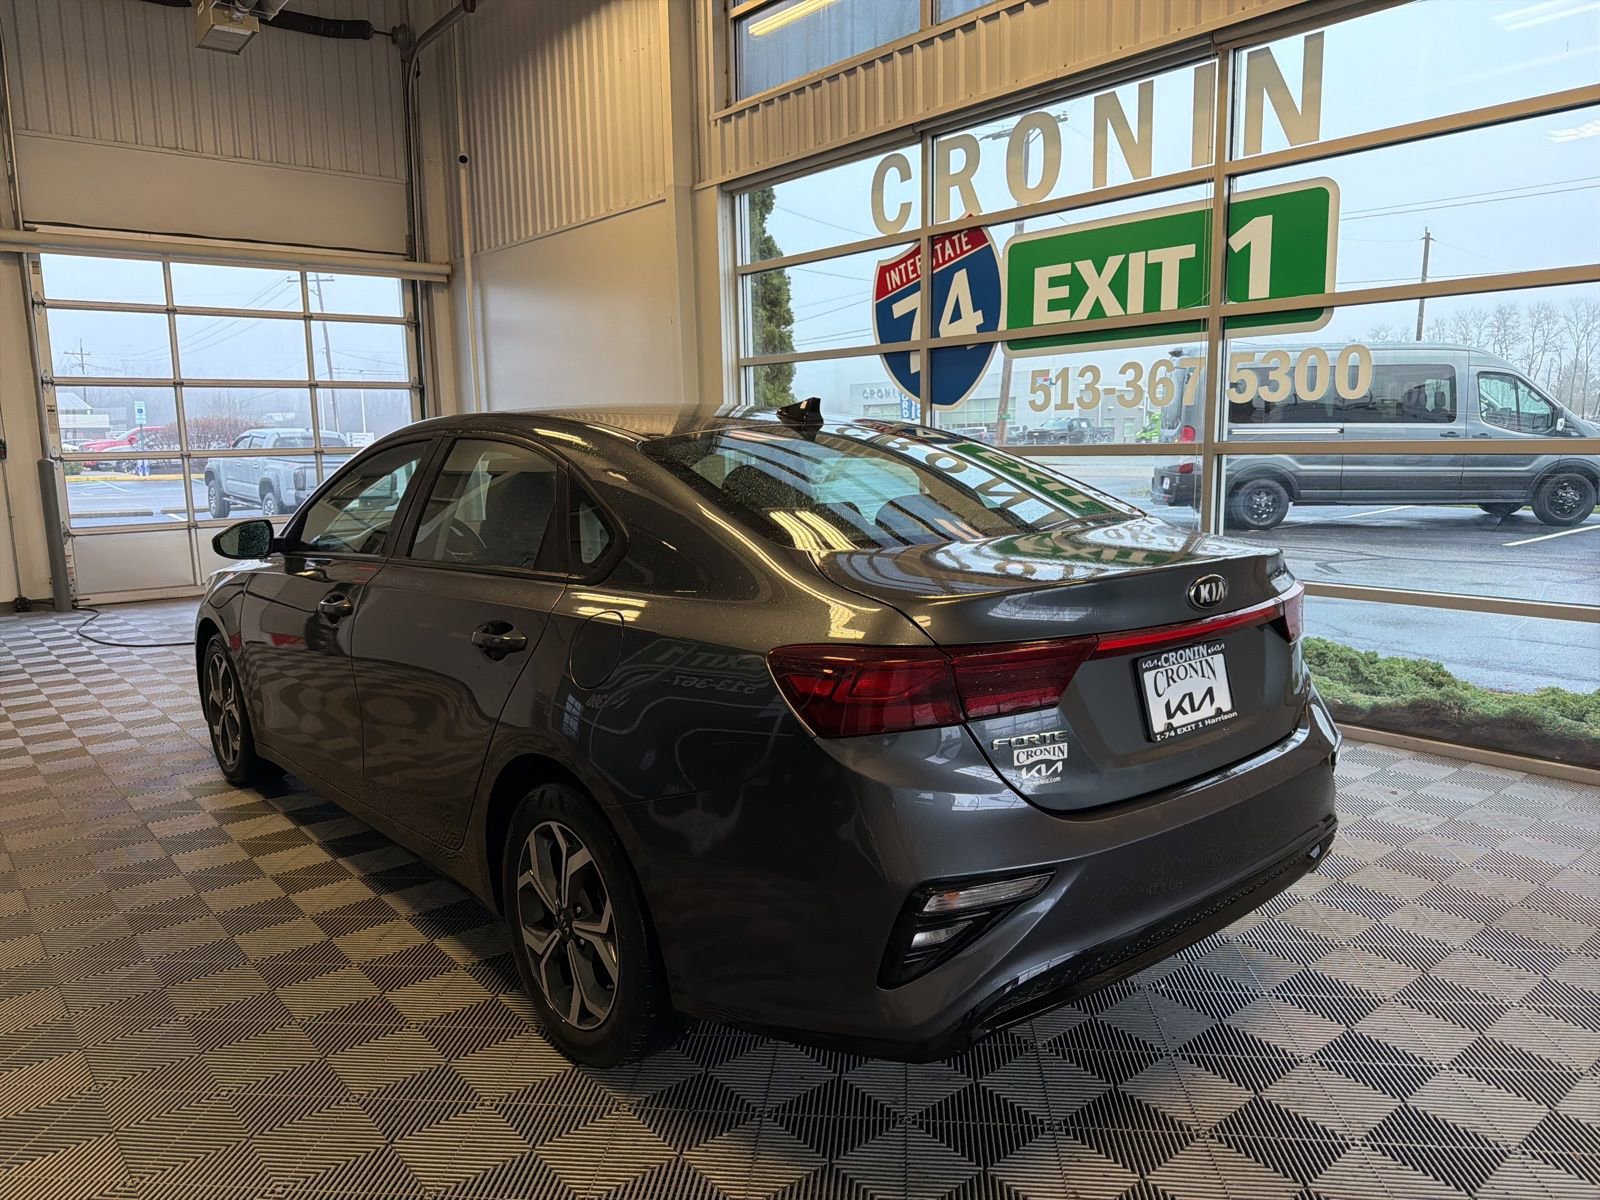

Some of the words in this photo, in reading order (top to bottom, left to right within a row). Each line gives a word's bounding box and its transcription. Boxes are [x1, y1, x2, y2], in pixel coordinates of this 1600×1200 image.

[871, 31, 1325, 236] CRONIN
[1033, 244, 1196, 325] EXIT
[1228, 214, 1274, 300] 1
[892, 268, 985, 374] 74
[1199, 581, 1225, 604] KIA
[1160, 644, 1208, 667] CRONIN
[1153, 657, 1218, 698] CRONIN
[992, 729, 1068, 750] FORTE
[1156, 730, 1175, 741] I-74
[1176, 724, 1197, 735] EXIT
[1198, 719, 1204, 728] 1
[1205, 711, 1238, 726] Harrison
[1016, 744, 1066, 764] CRONIN
